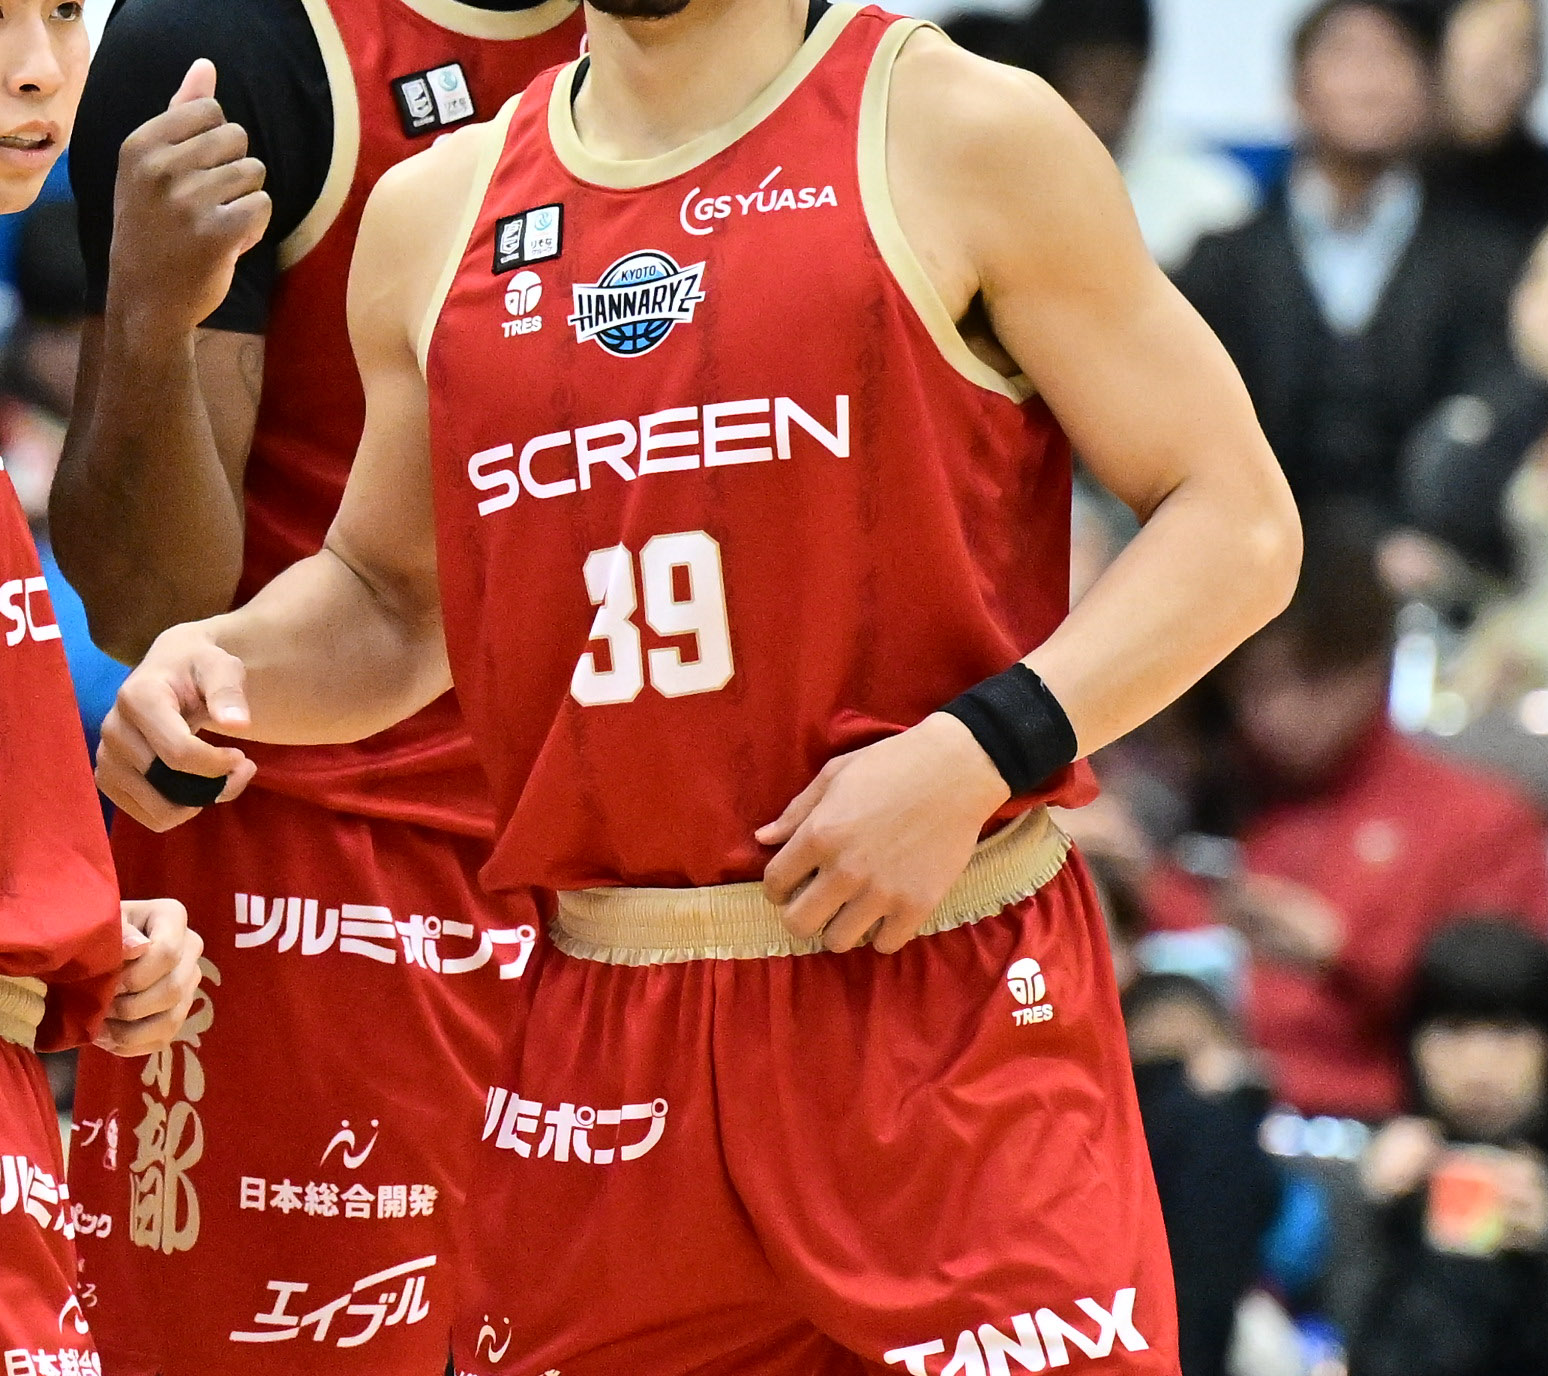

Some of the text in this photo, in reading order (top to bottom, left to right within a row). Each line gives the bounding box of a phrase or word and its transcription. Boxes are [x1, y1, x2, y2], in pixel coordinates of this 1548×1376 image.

[570, 272, 702, 332] HANNARYZ
[621, 265, 656, 282] KYOTO
[501, 315, 543, 338] TRES
[467, 394, 850, 517] SCREEN
[570, 530, 736, 707] 39
[235, 892, 537, 980] ツルミポンプ
[1012, 1003, 1054, 1027] TRES
[239, 1176, 438, 1220] 日本総合開発
[229, 1255, 437, 1347] エイブル
